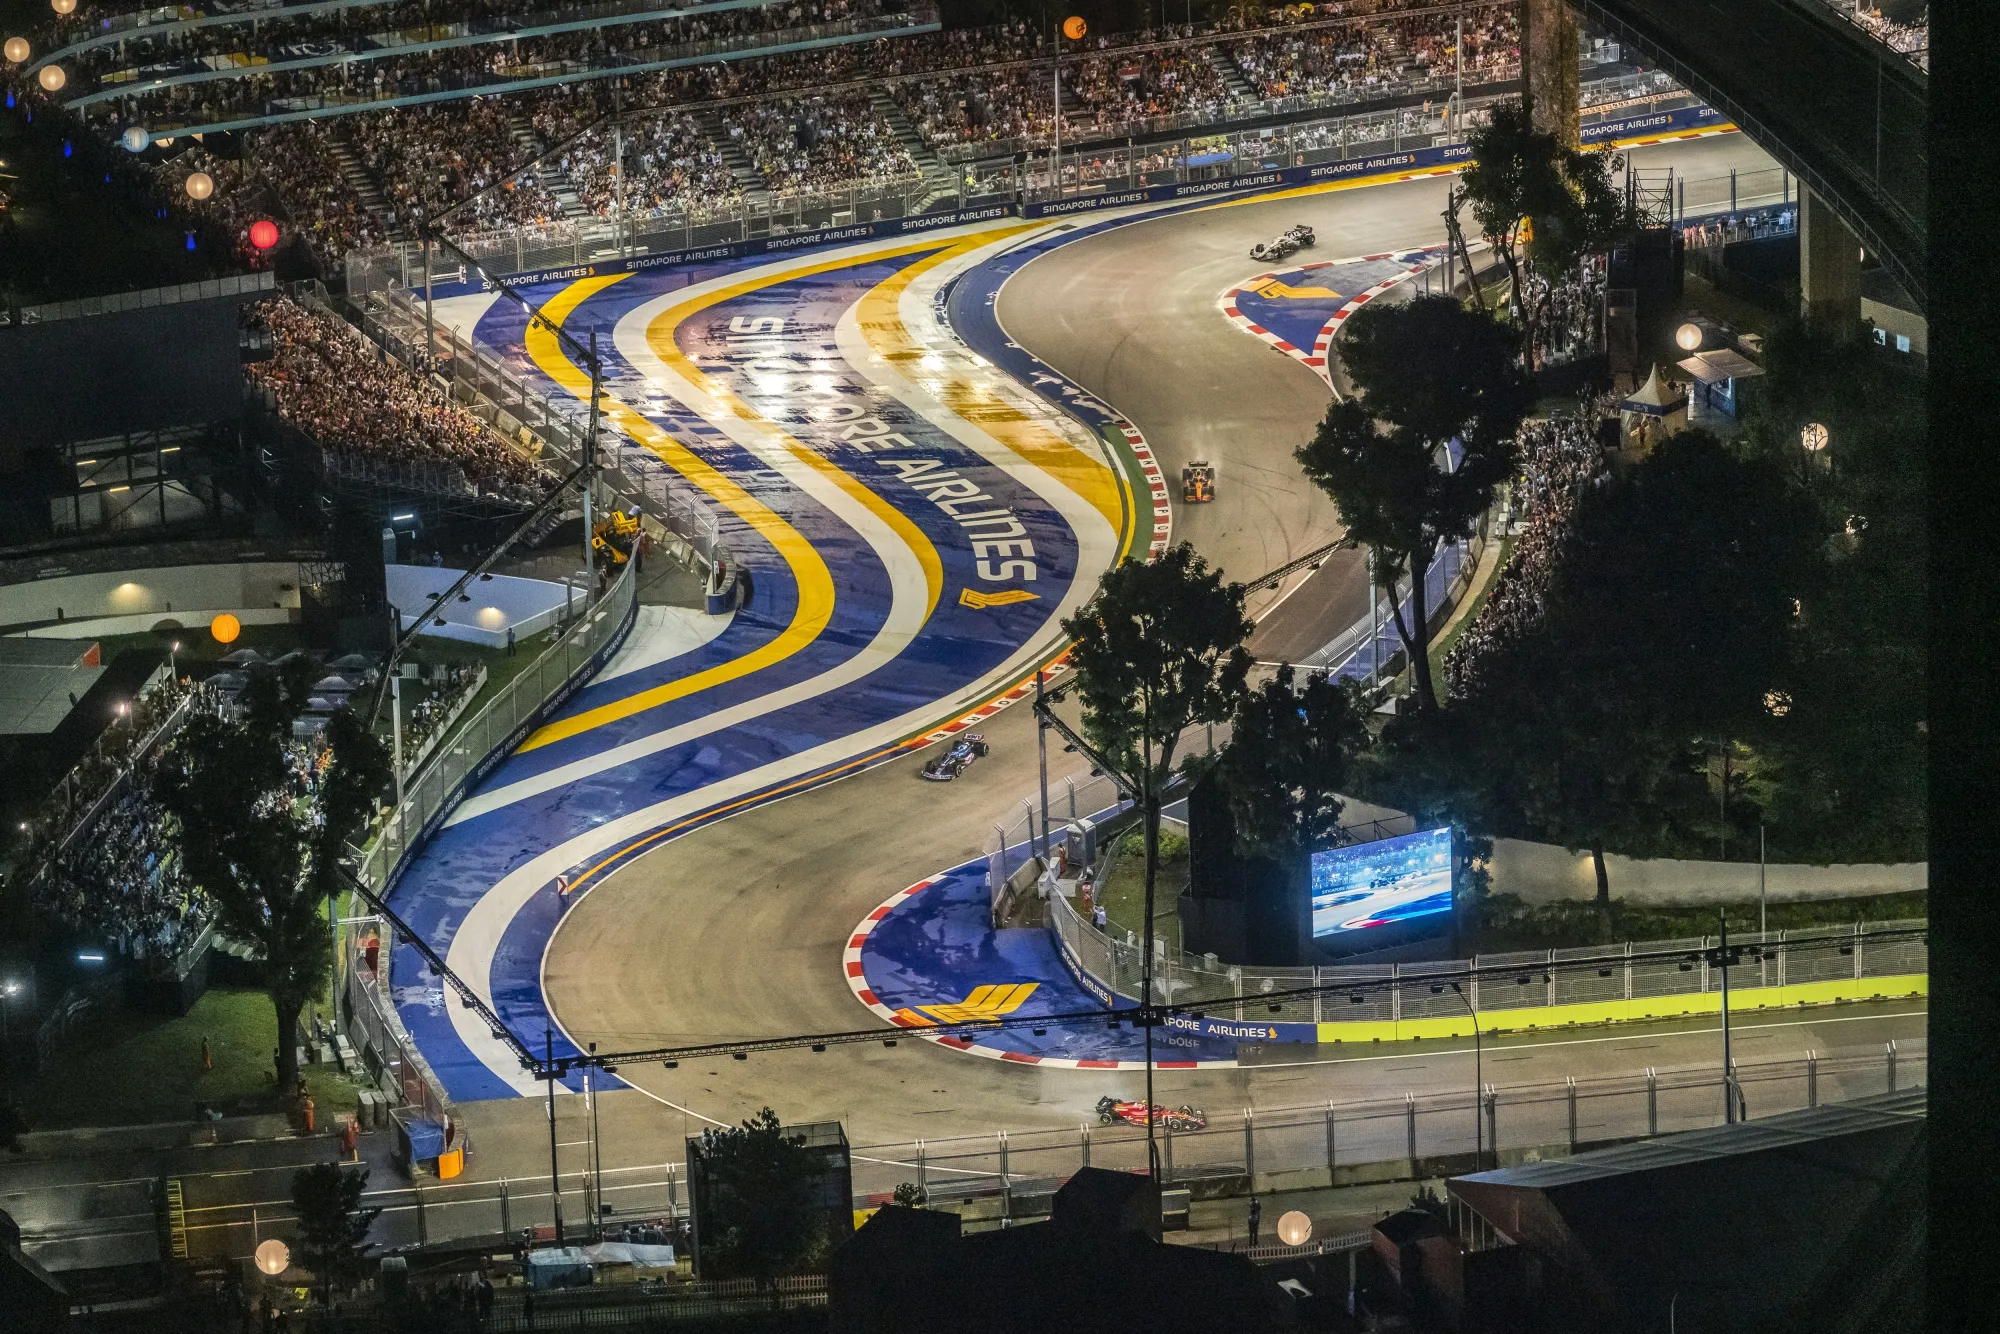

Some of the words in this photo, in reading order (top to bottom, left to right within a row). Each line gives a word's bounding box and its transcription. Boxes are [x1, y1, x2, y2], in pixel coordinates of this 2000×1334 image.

[1580, 123, 1624, 137] INGAPORE
[1626, 115, 1666, 129] AIRLINES
[1310, 161, 1364, 177] SINGAPORE
[1366, 155, 1408, 169] AIRLINES
[1176, 181, 1230, 195] SINGAPORE
[1232, 174, 1275, 188] AIRLINES
[1042, 199, 1097, 214] SINGAPORE
[1099, 192, 1142, 206] AIRLINES
[902, 214, 956, 230] SINGAPORE
[958, 208, 1002, 222] AIRLINES
[766, 234, 821, 249] SINGAPORE
[824, 227, 867, 241] AIRLINES
[626, 254, 682, 270] SINGAPORE
[684, 248, 729, 262] AIRLINES
[542, 267, 587, 281] AIRLINES
[875, 459, 1037, 581] AIRLINES
[1082, 976, 1108, 1002] AIRLINES
[1207, 1023, 1267, 1038] AIRLINES
